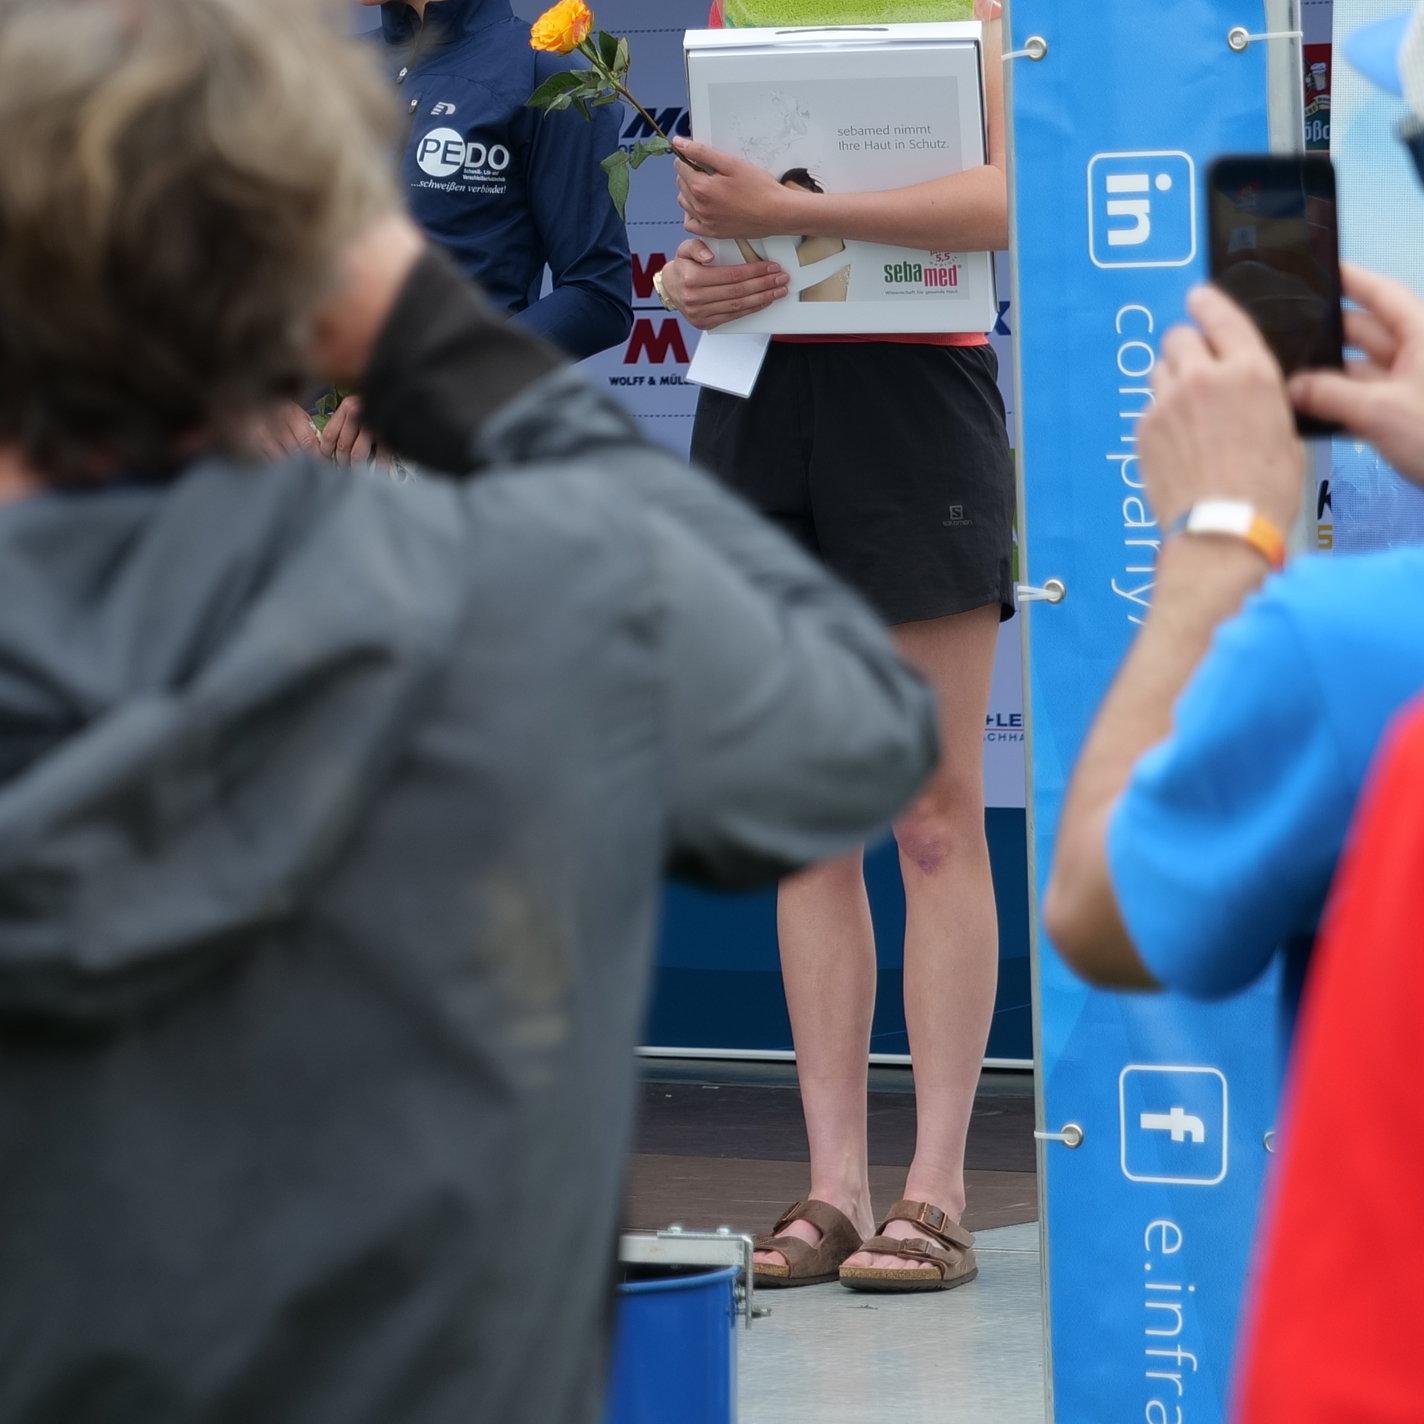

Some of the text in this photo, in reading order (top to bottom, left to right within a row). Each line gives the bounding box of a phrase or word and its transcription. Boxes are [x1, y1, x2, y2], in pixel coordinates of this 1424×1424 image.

[837, 124, 932, 138] sebamed nimmt
[838, 138, 950, 151] Ihre Haut in Schutz.
[419, 137, 510, 170] PEDO
[609, 376, 656, 387] WOLFF &
